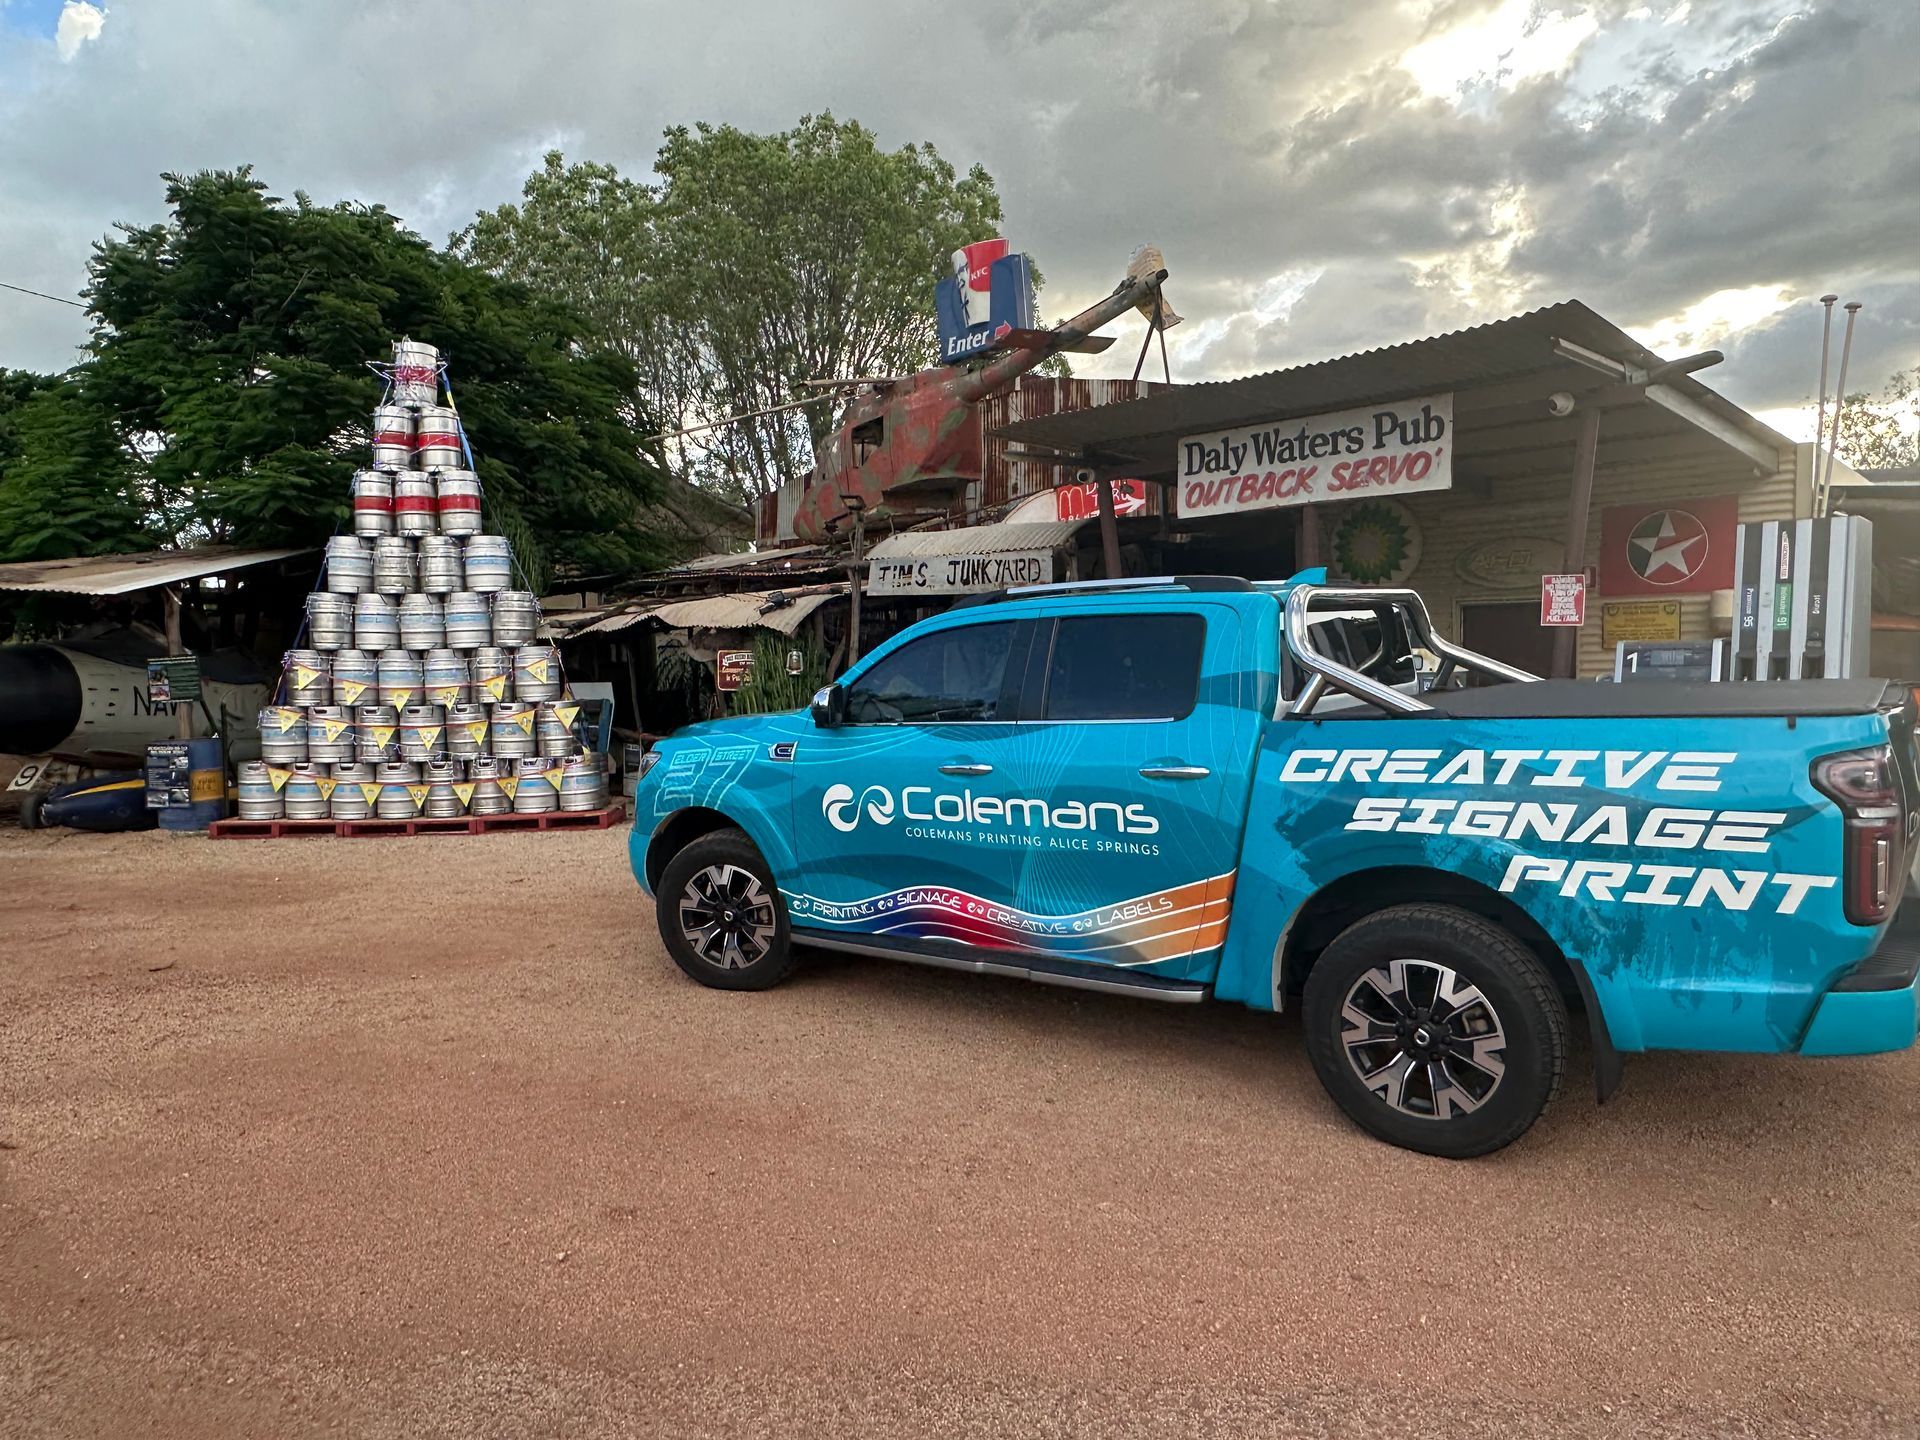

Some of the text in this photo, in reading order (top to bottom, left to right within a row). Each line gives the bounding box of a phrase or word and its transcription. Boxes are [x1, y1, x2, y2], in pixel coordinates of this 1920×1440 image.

[971, 266, 988, 281] KFC
[947, 329, 990, 356] Enter
[1184, 405, 1445, 476] Daly Waters Pub
[947, 557, 1041, 587] JUNKYARD
[1744, 616, 1754, 627] 95
[1777, 617, 1787, 626] 91
[1627, 652, 1638, 673] 1
[715, 749, 752, 761] STREET
[1279, 749, 1738, 792] CREATIVE
[902, 786, 1160, 835] Colemans
[1344, 797, 1787, 853] SIGNAGE
[905, 827, 1160, 856] COLEMANS PRINTING ALICE SPRINGS
[1498, 855, 1837, 915] PRINT
[813, 891, 1173, 933] PRINTING SIGNAGE CREATIVE LABELS
